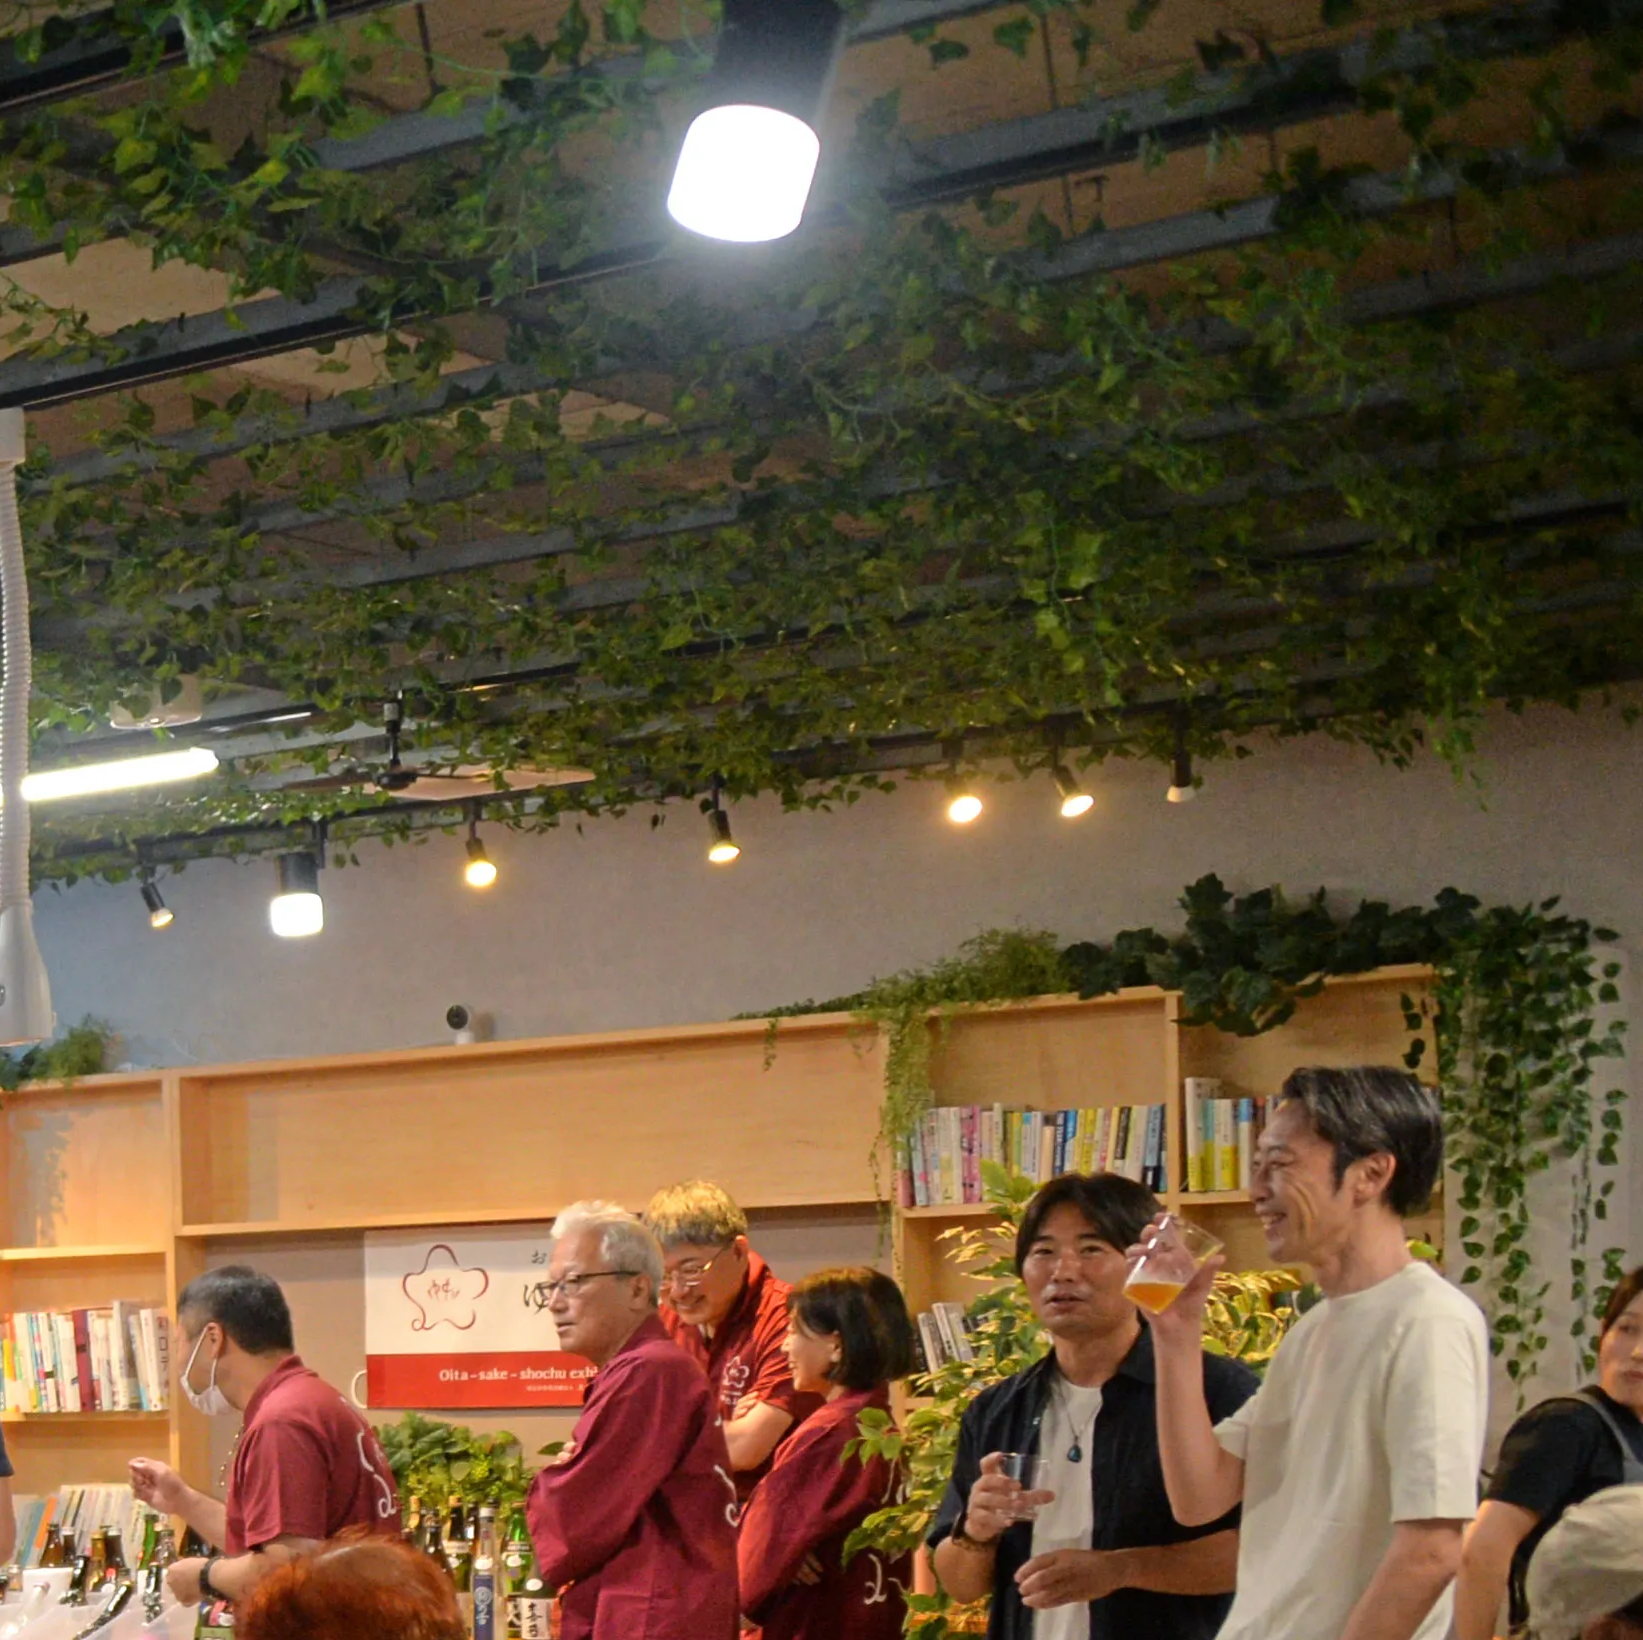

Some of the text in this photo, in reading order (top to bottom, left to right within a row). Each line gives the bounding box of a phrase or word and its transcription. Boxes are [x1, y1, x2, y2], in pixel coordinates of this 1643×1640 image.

[439, 1368, 469, 1381] Oita
[478, 1367, 508, 1380] sake
[519, 1366, 566, 1379] shochu
